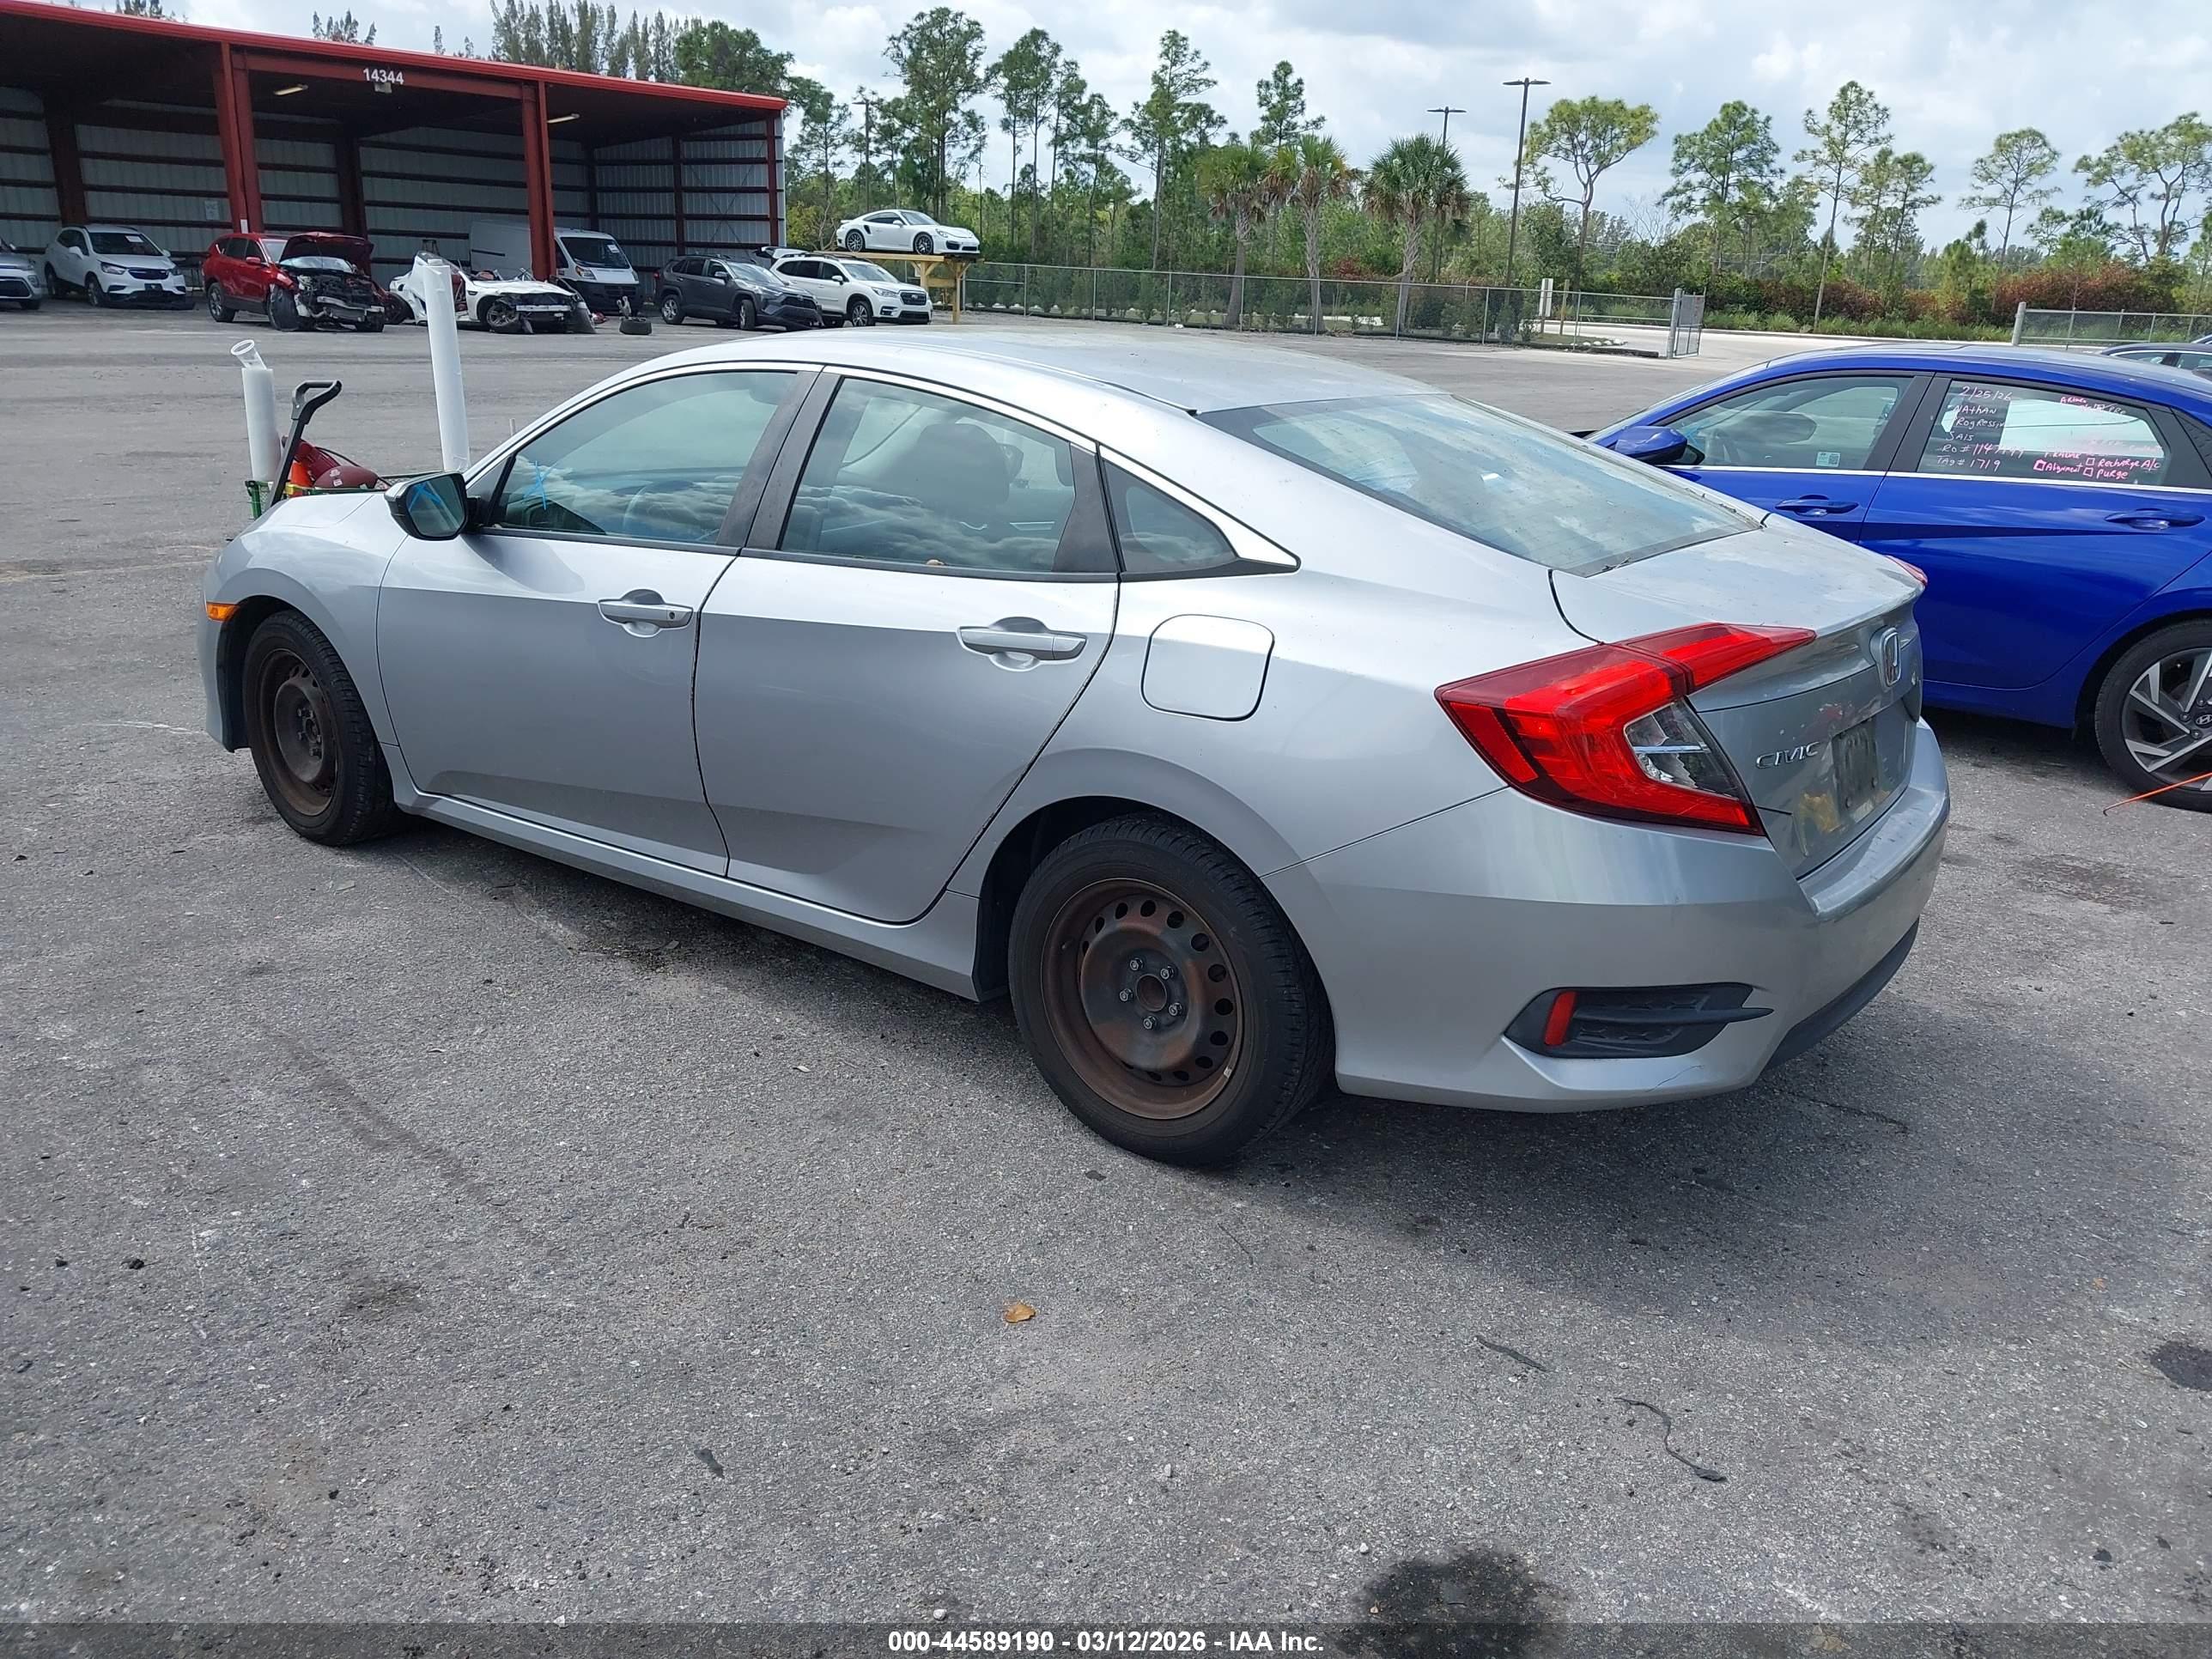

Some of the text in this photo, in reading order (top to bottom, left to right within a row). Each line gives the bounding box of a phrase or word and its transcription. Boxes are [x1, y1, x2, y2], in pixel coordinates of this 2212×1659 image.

[363, 68, 404, 85] 14344
[1959, 386, 2012, 400] 2/25/26
[1970, 459, 2001, 472] 1719
[1756, 741, 1820, 769] CIVIC
